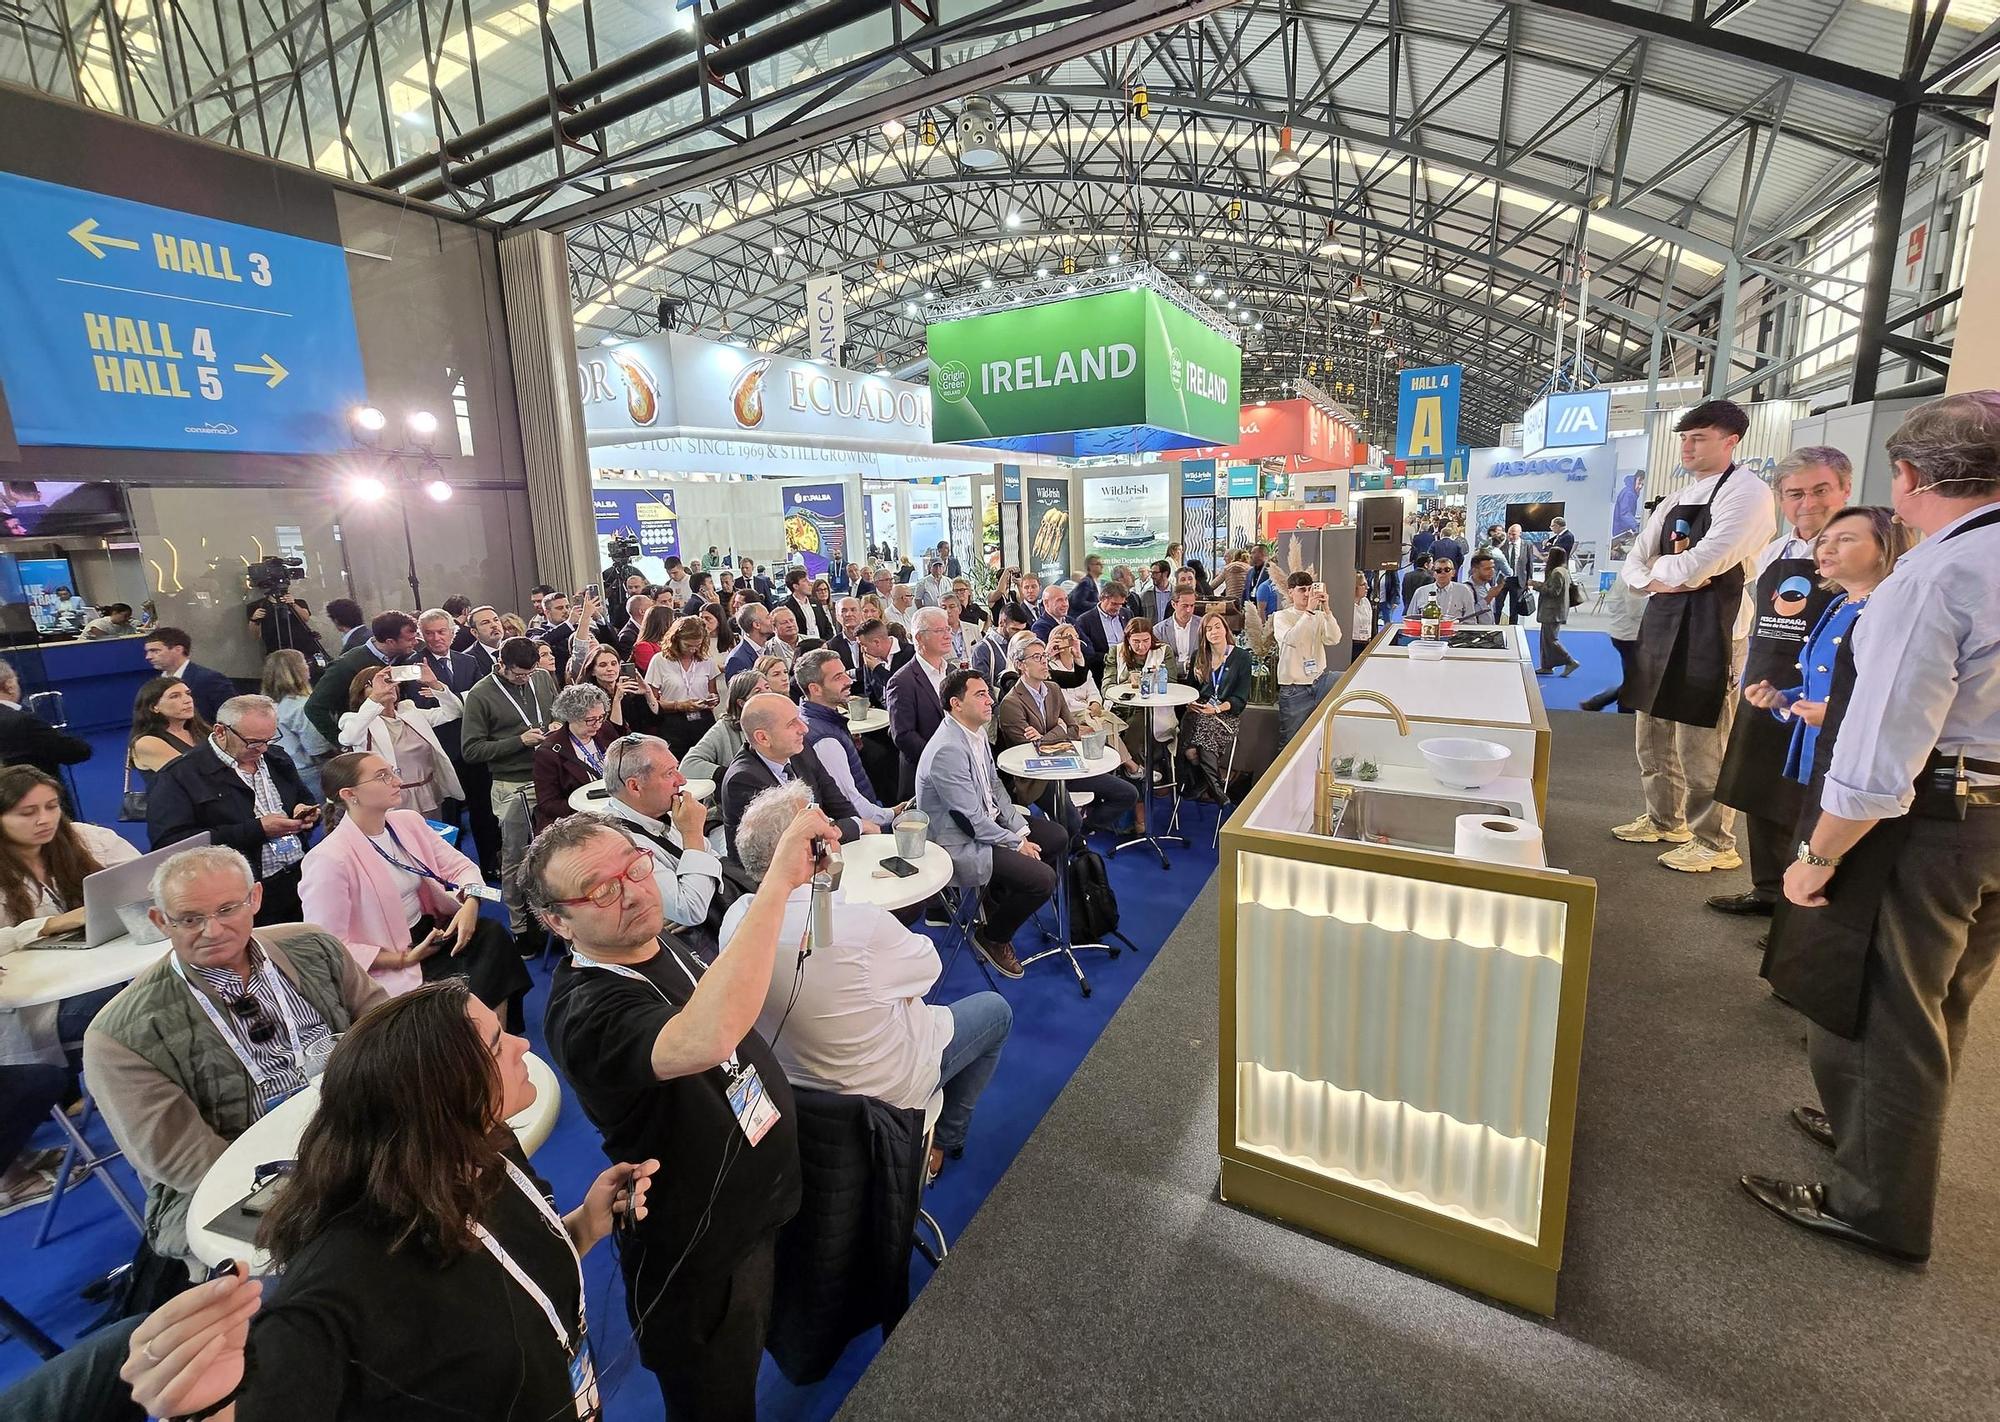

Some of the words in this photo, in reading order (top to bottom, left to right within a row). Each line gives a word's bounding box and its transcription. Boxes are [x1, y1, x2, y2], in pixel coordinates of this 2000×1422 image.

[152, 233, 243, 283] HALL
[248, 252, 273, 287] 3
[83, 312, 184, 359] HALL
[192, 328, 217, 362] 4
[817, 285, 837, 367] ANCA
[94, 355, 191, 398] HALL
[197, 366, 224, 401] 5
[942, 370, 965, 382] Origin
[942, 381, 966, 390] Green
[981, 342, 1137, 395] IRELAND
[1186, 360, 1228, 405] IRELAND
[1411, 375, 1438, 391] HALL
[1440, 374, 1449, 388] 4
[1408, 396, 1443, 457] A
[738, 445, 765, 460] 1969
[766, 443, 778, 459] &
[1449, 457, 1464, 482] A
[1101, 485, 1123, 496] Wild
